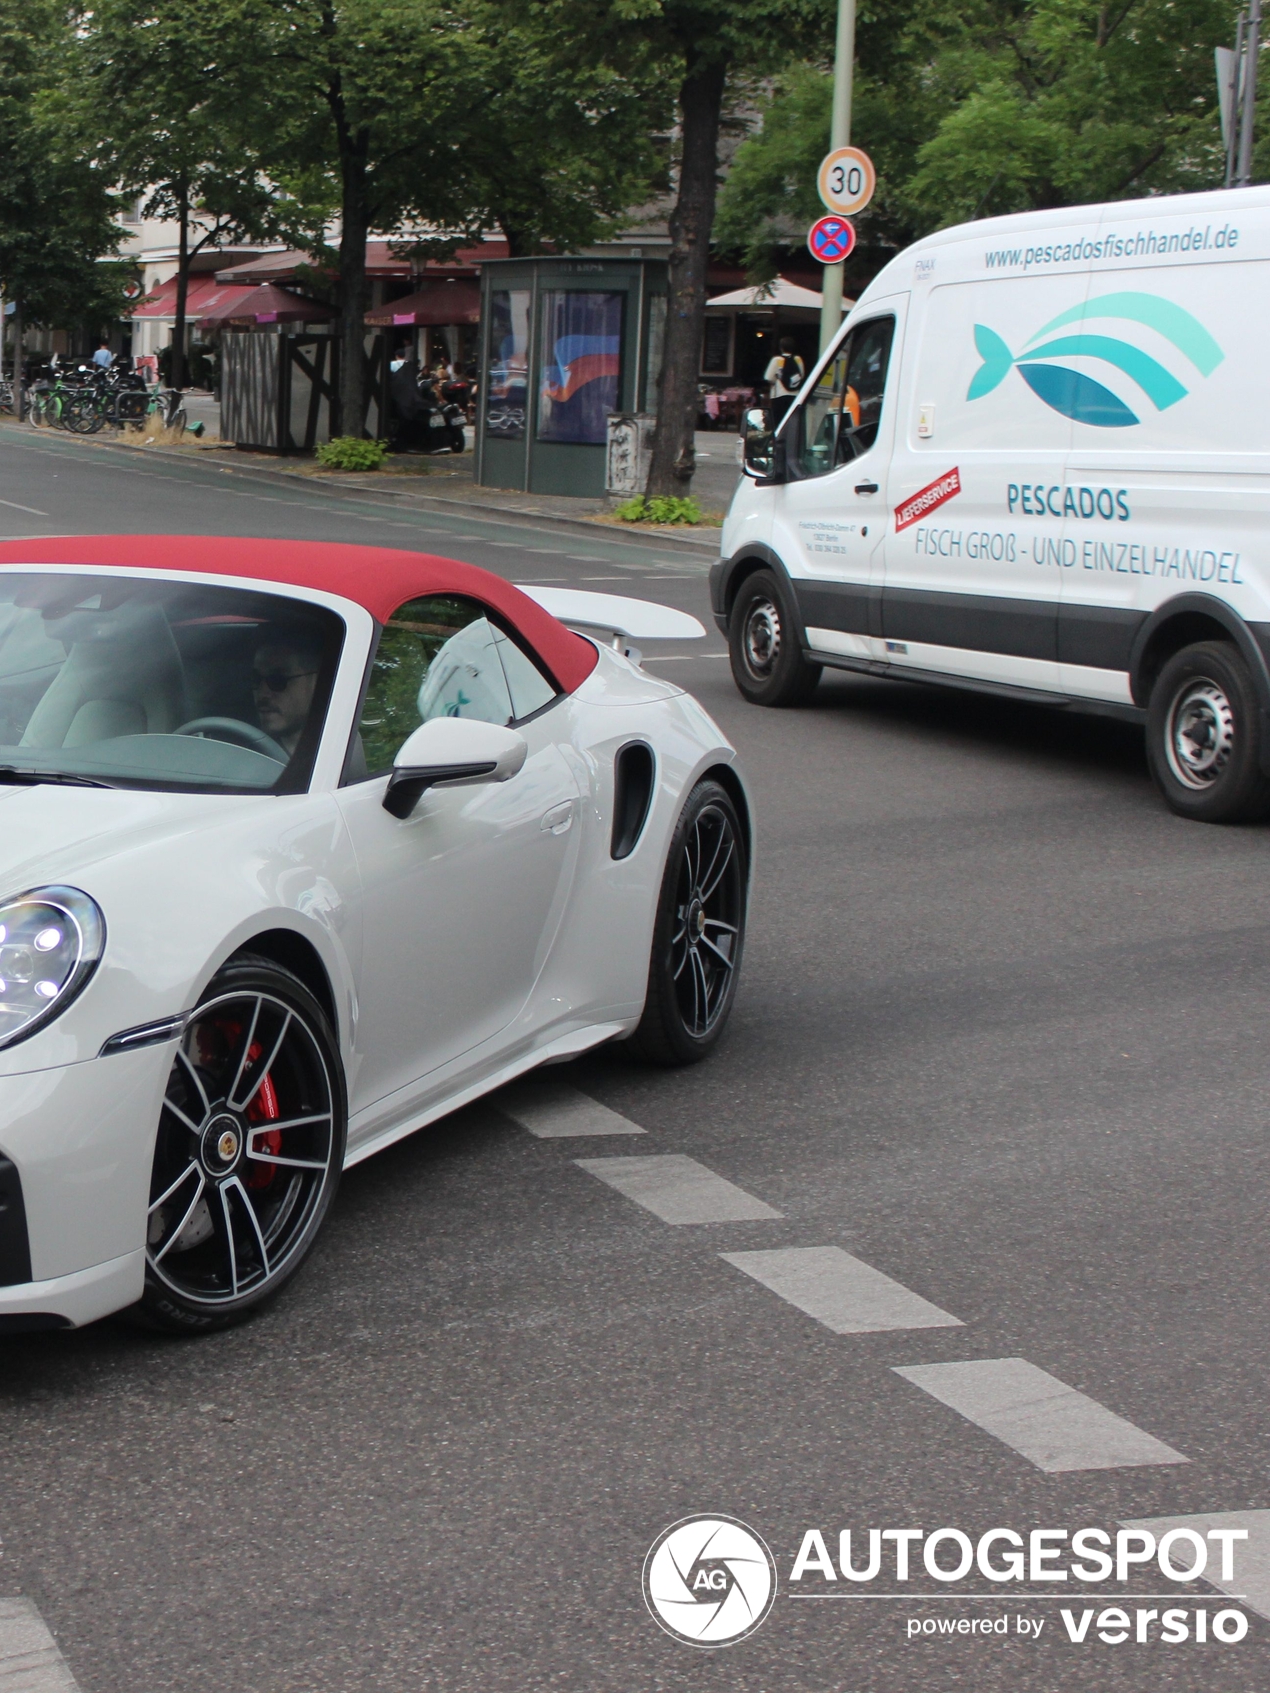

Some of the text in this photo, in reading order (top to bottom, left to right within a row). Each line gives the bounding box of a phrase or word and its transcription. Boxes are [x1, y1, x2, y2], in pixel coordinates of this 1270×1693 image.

[831, 166, 861, 195] 30
[985, 223, 1239, 270] www.pescadosfischhandel.de
[897, 474, 959, 526] LIEFERSERVICE
[1007, 483, 1130, 521] PESCADOS
[916, 528, 962, 558] FISCH
[966, 531, 1016, 562] GROß
[1033, 536, 1076, 568] UND
[1083, 541, 1243, 584] EINZELHANDEL
